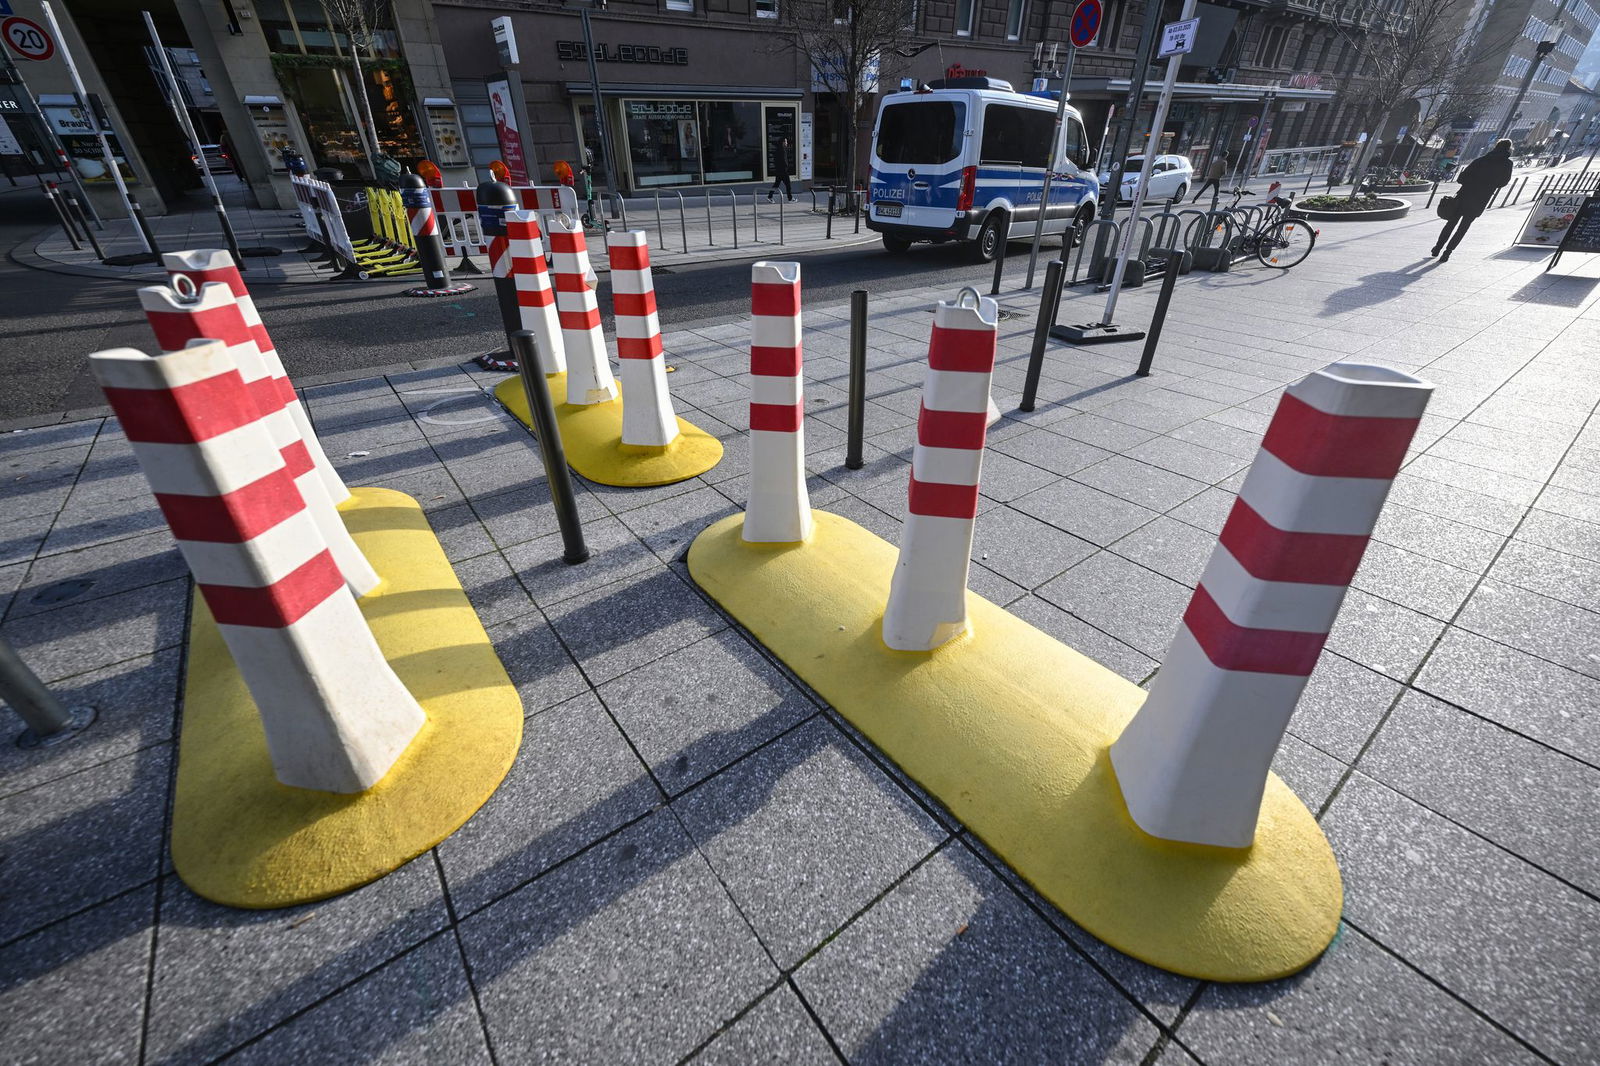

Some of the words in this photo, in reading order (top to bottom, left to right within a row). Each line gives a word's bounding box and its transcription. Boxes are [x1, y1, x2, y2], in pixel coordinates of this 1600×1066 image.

[13, 29, 44, 49] 20
[873, 187, 906, 199] POLIZEI
[1026, 191, 1043, 201] POLIZ
[1545, 196, 1581, 207] DEAL
